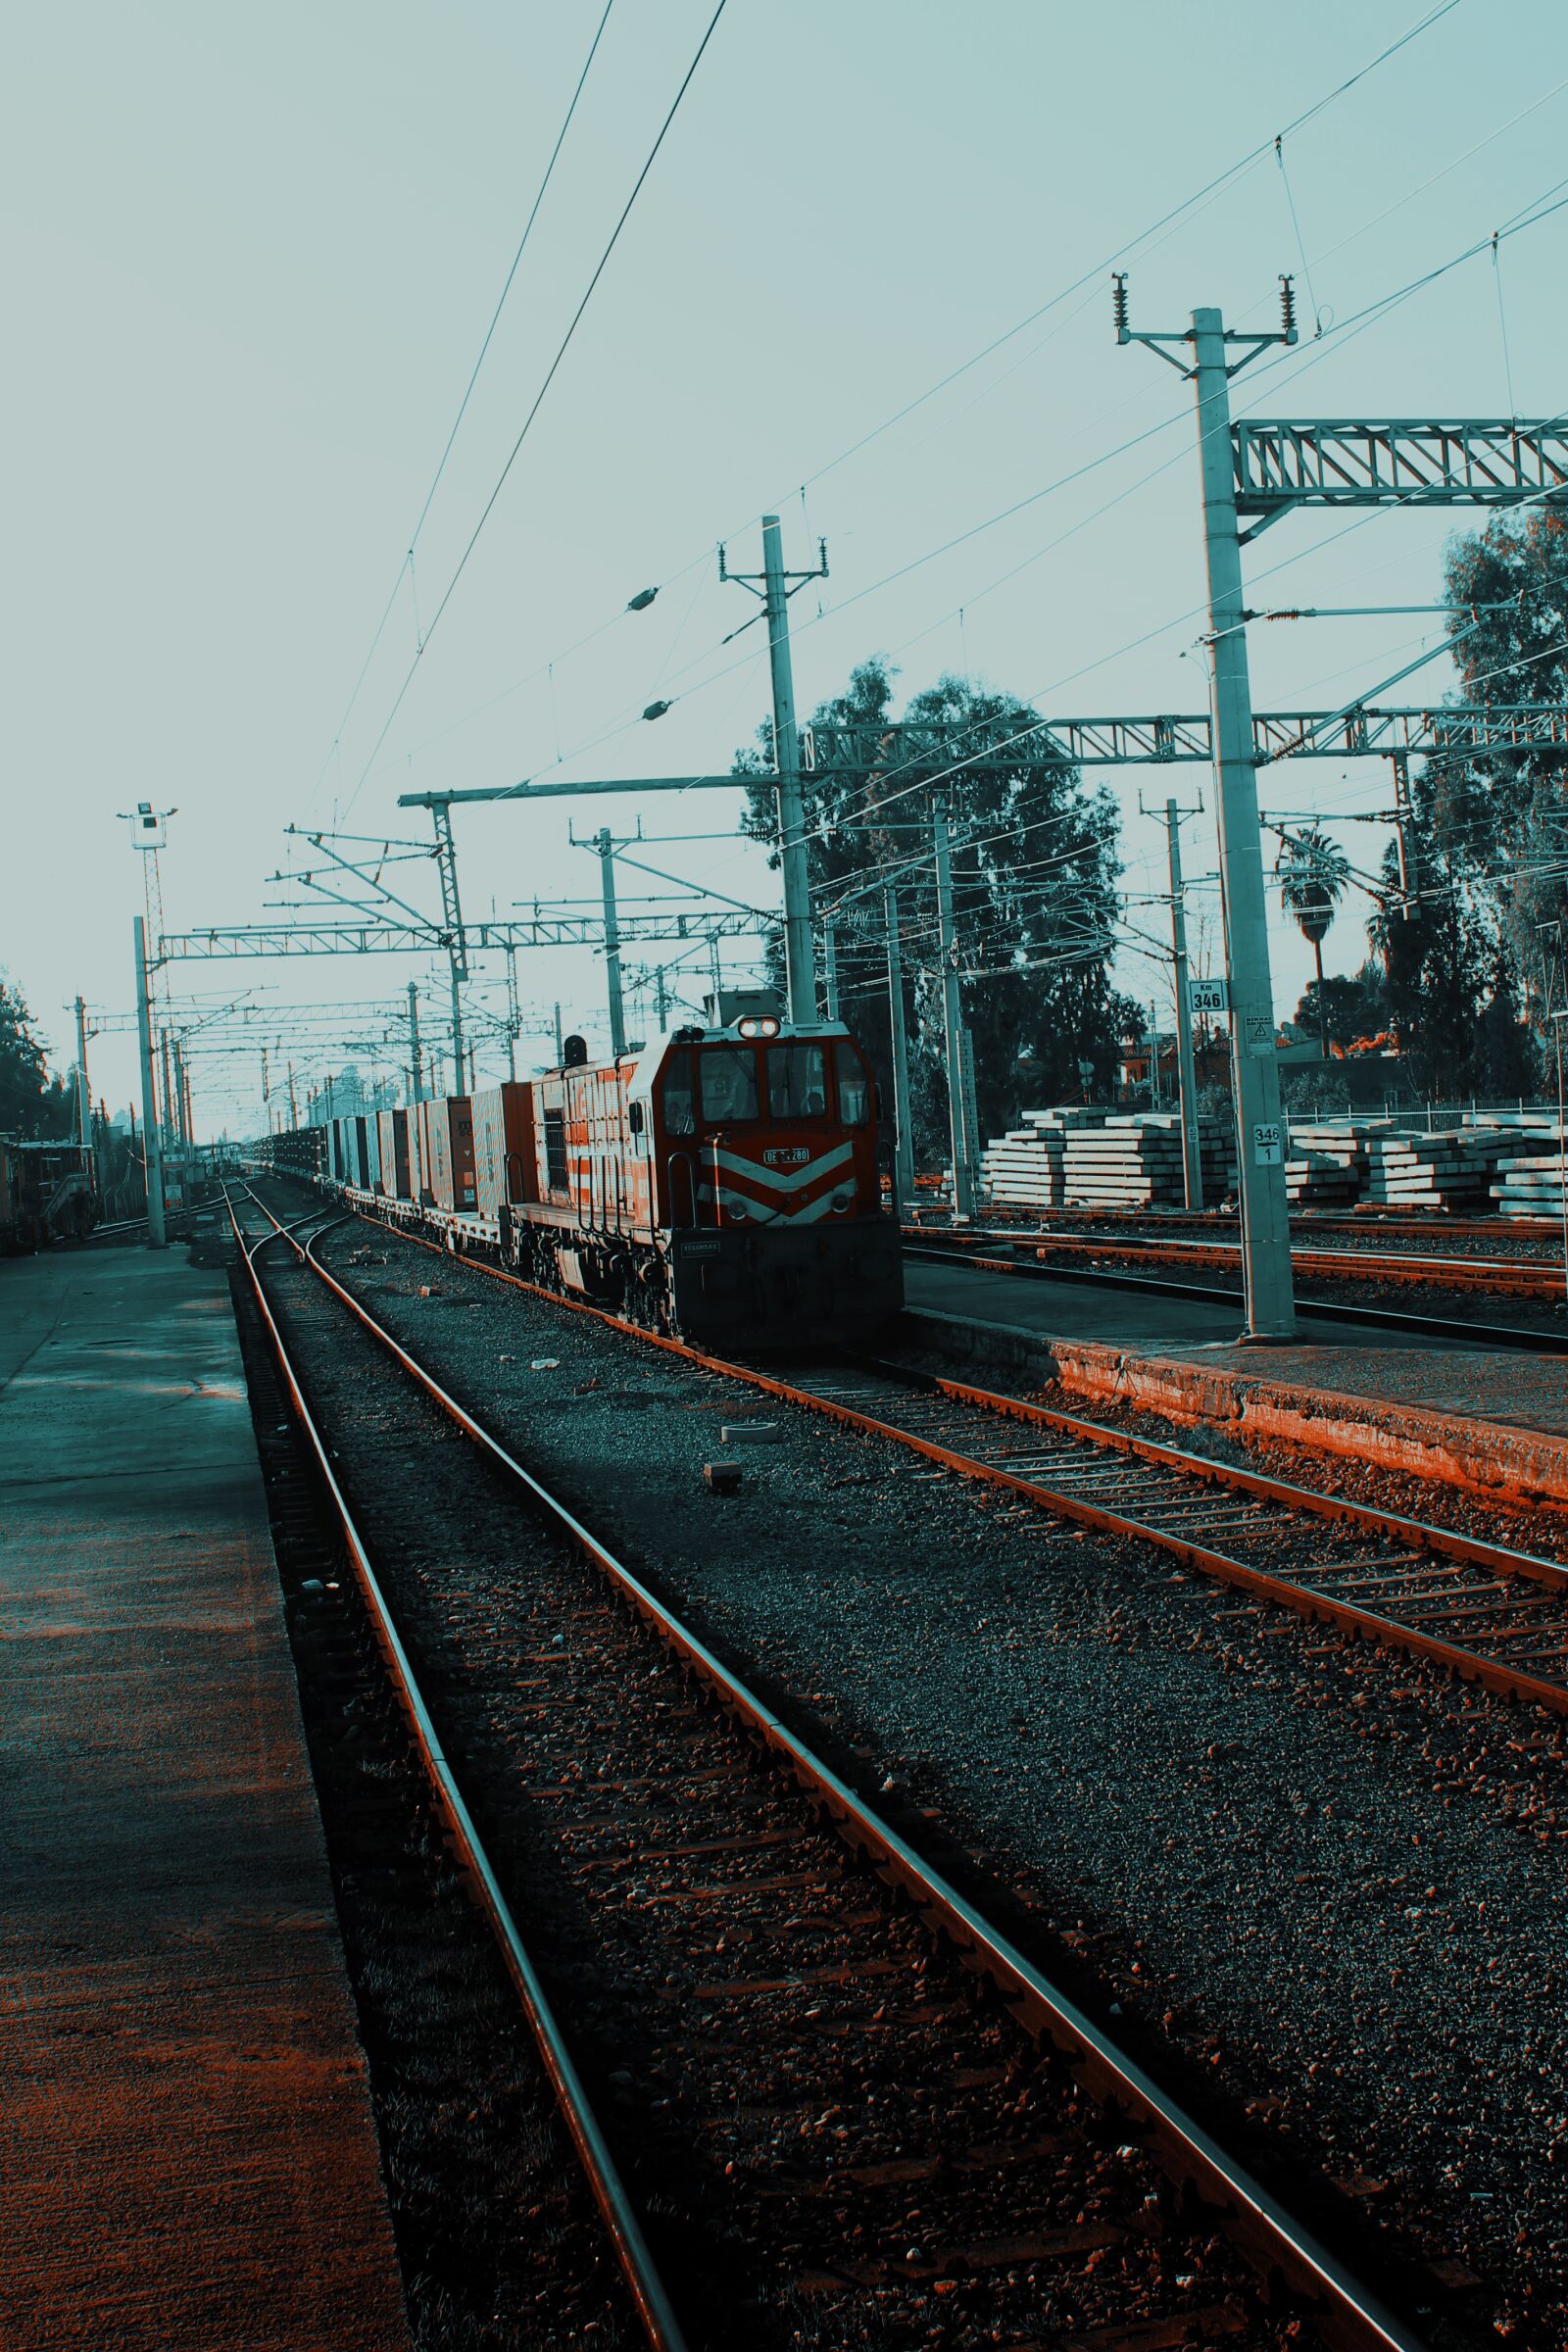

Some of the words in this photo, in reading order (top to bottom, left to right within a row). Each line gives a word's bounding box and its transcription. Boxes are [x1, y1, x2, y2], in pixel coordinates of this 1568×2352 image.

[1194, 993, 1220, 1008] 346
[1254, 1128, 1279, 1142] 346
[792, 1150, 807, 1160] 280
[1264, 1149, 1271, 1160] 1
